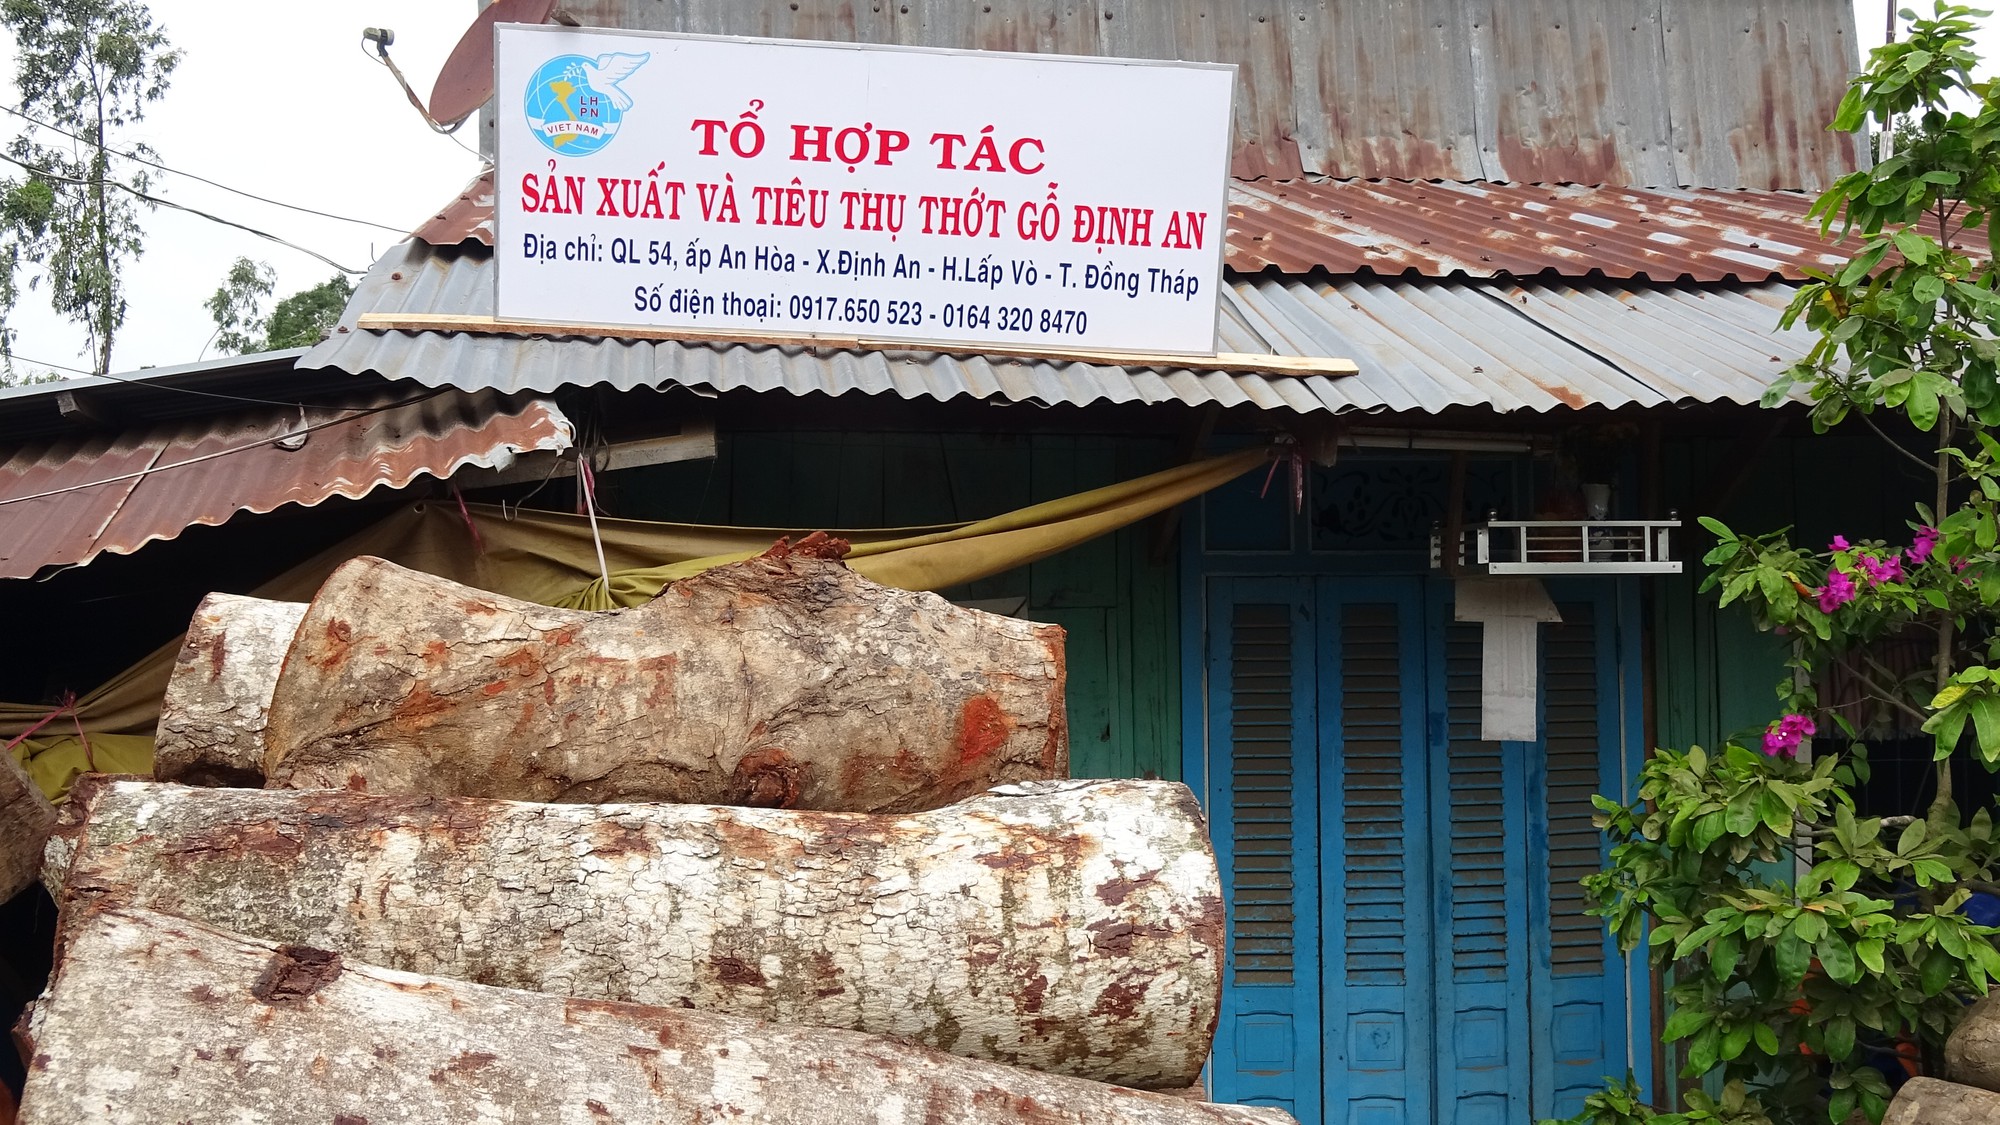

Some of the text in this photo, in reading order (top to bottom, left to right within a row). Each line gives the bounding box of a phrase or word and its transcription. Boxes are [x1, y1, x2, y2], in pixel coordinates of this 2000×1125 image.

[547, 123, 599, 136] VIET NAM
[691, 99, 1044, 175] TỔ HỢP TÁC
[522, 160, 1207, 253] SẢN XUẤT VÀ TIÊU THỤ THỚT GỖ ĐỊNH AN
[524, 234, 556, 264] Địa
[565, 234, 602, 261] chỉ:
[612, 238, 640, 264] QL
[649, 241, 677, 271] 54,
[686, 238, 711, 274] ấp
[719, 244, 745, 269] An
[755, 246, 794, 272] Hòa
[816, 249, 885, 281] X.Định
[893, 254, 920, 279] An
[943, 254, 1002, 290] H.Lấp
[1012, 260, 1037, 285] Vò
[1060, 263, 1076, 288] T.
[1085, 261, 1139, 298] Đồng
[1148, 268, 1198, 301] Tháp
[635, 283, 663, 312] Số
[670, 289, 714, 319] điện
[722, 292, 780, 322] thoại:
[790, 295, 879, 323] 0917.650
[887, 301, 921, 325] 523
[943, 304, 990, 329] 0164
[998, 307, 1032, 332] 320
[1040, 309, 1087, 335] 8470
